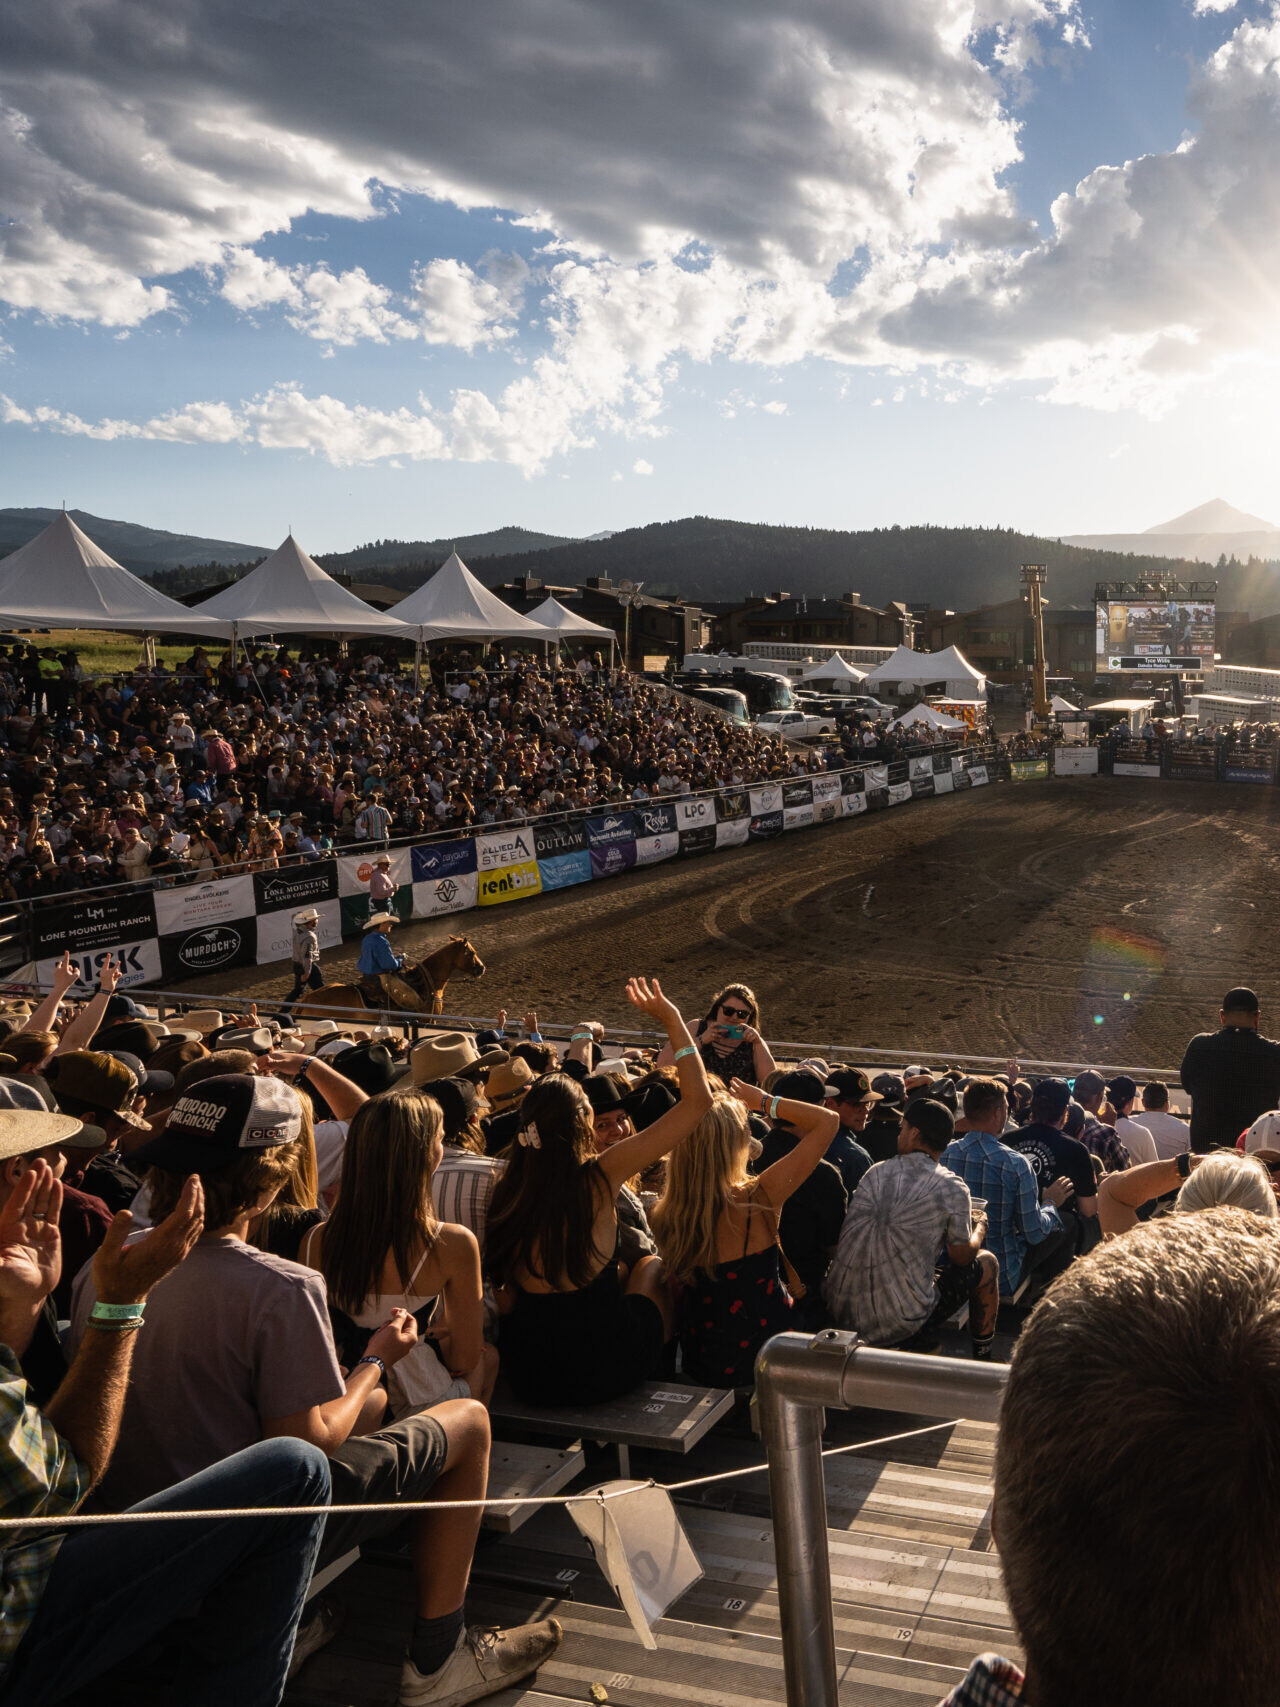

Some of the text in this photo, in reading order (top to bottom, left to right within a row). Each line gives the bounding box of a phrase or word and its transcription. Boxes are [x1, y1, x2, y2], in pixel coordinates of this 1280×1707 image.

[685, 803, 706, 818] LPC
[482, 843, 514, 855] ALLIED
[537, 833, 583, 851] OUTLAW
[482, 851, 525, 866] STEEL
[264, 879, 330, 900] LONE MOUNTAIN
[482, 869, 538, 895] rentbiz
[275, 888, 320, 902] LAND COMPANY
[40, 915, 152, 943] LONE MOUNTAIN RANCH
[184, 938, 237, 960] MURDOCH'S
[560, 1569, 577, 1580] 17
[727, 1599, 742, 1610] 18
[897, 1629, 912, 1640] 19
